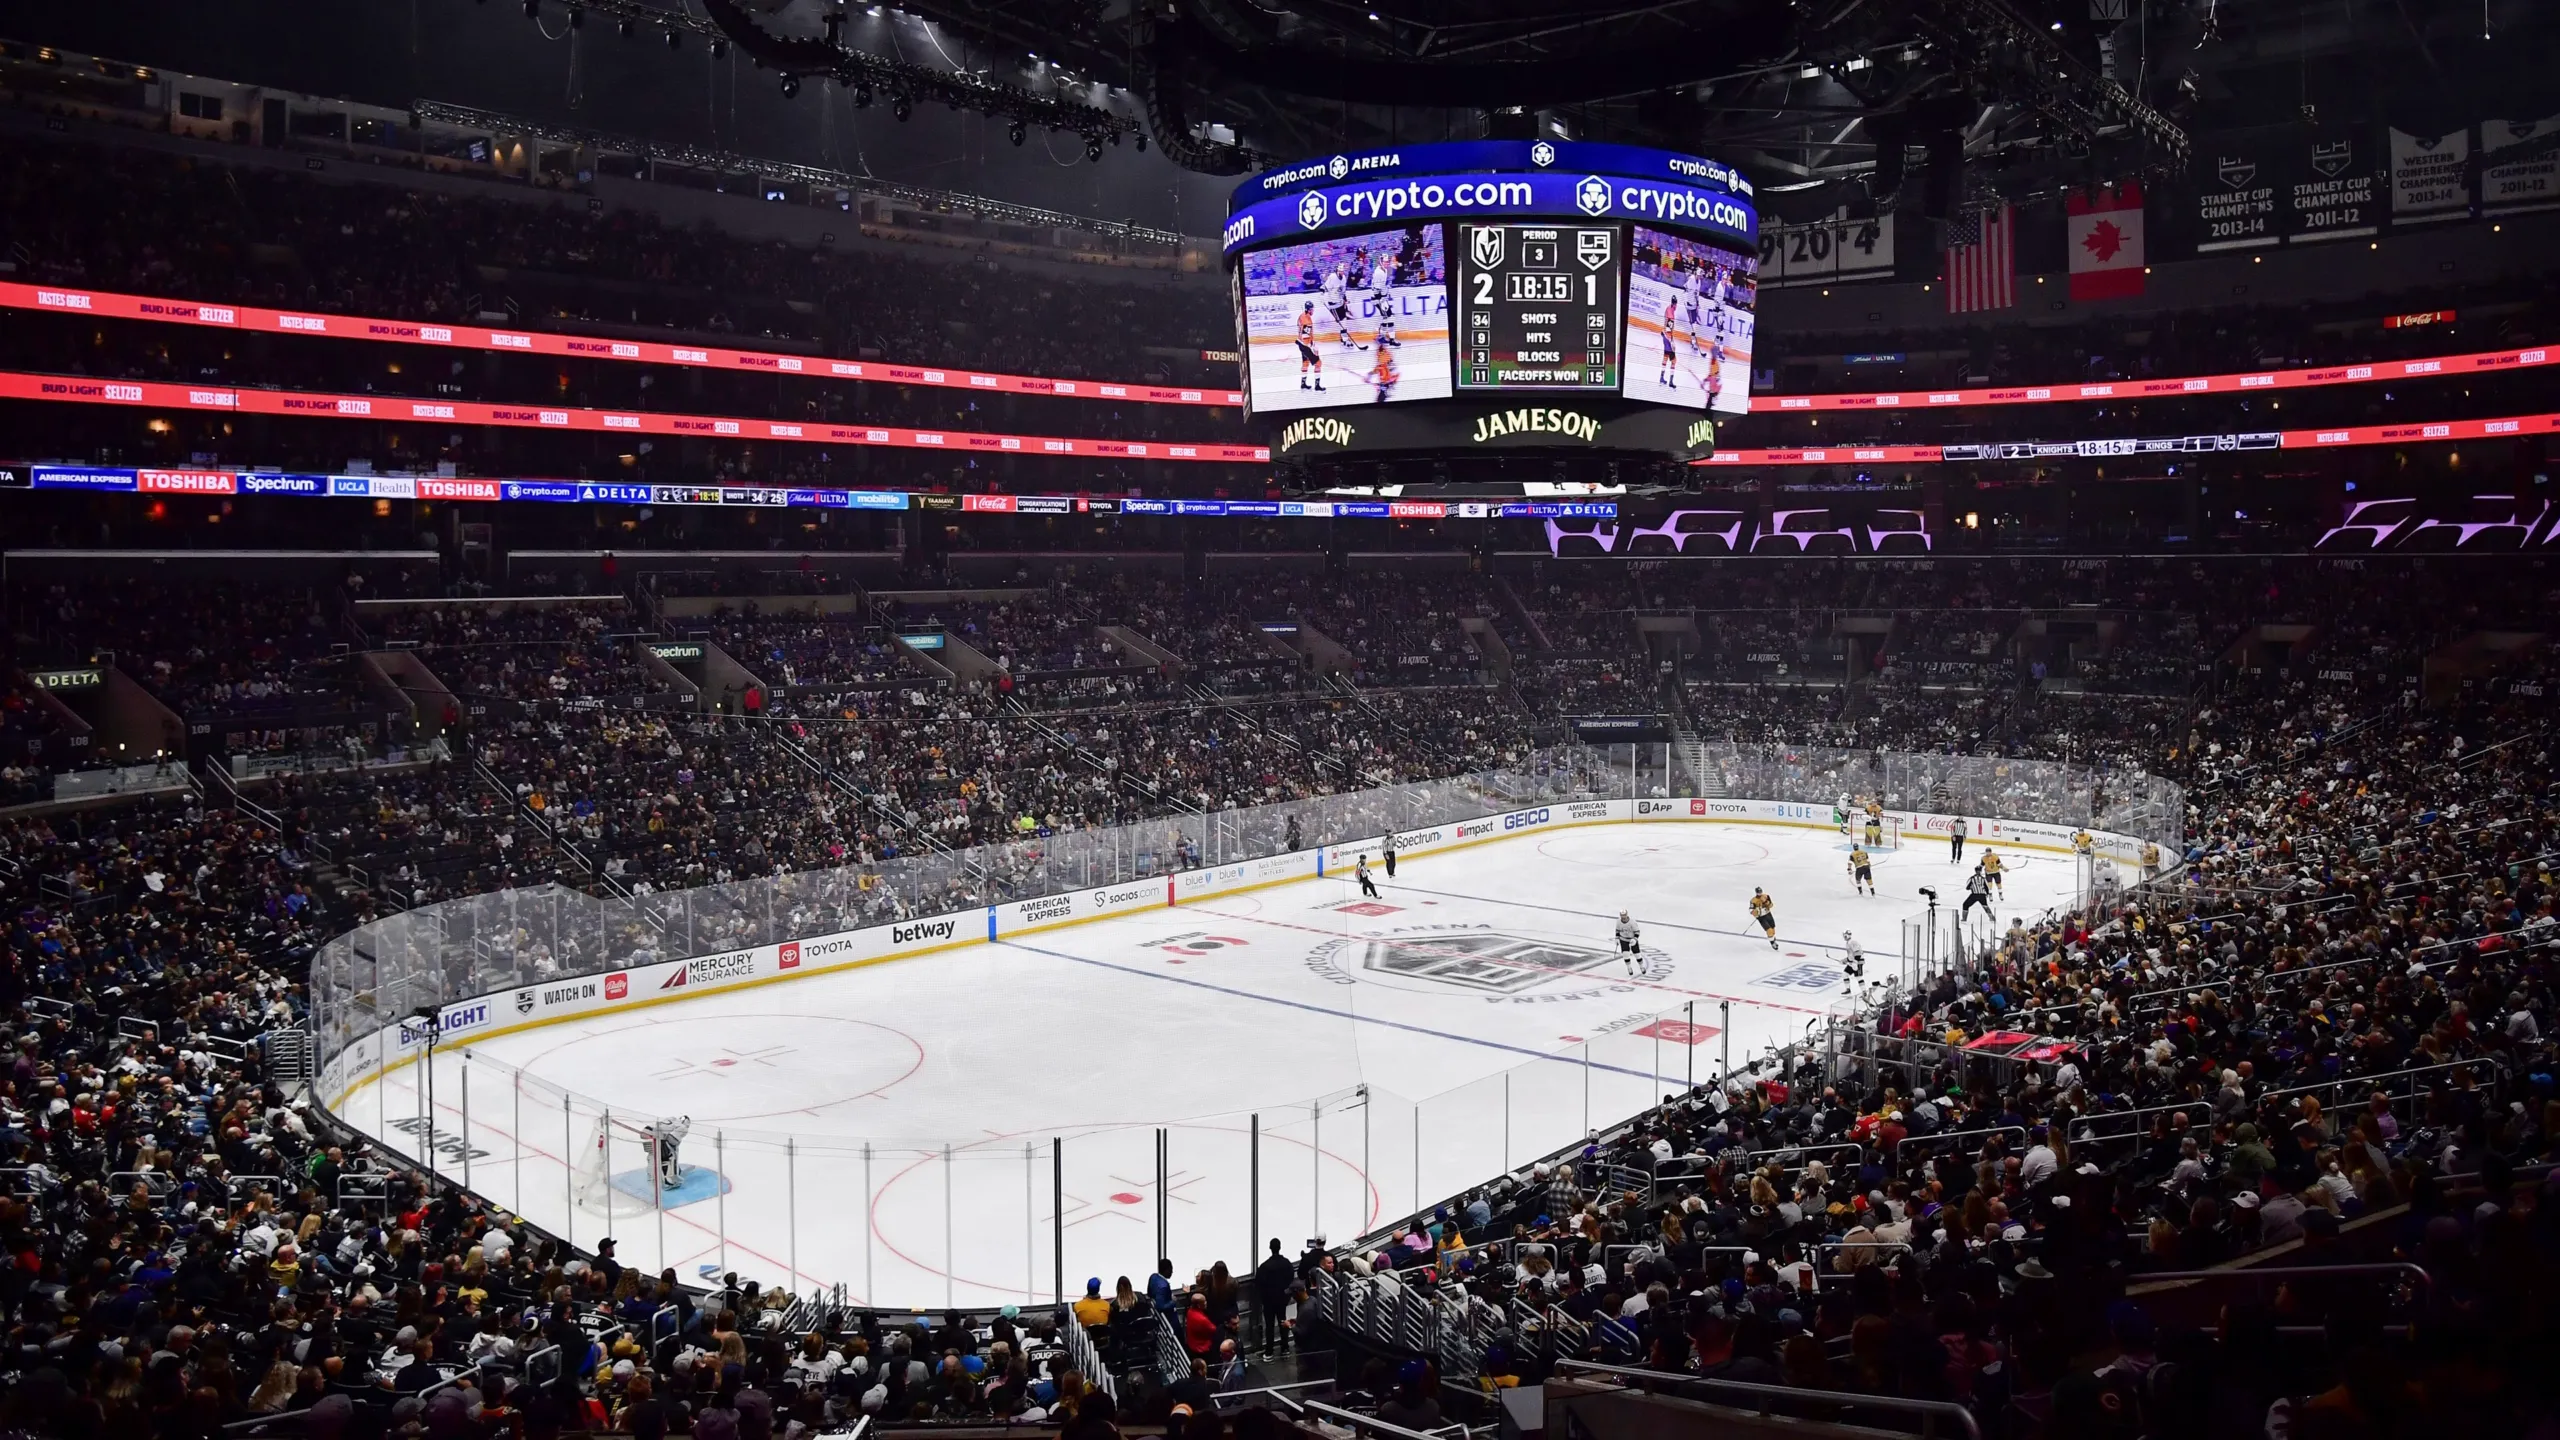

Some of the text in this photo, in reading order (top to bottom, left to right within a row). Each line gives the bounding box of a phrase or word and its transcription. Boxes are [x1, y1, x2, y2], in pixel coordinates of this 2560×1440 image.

[2403, 153, 2455, 166] WESTERN
[1263, 154, 1400, 189] crypto.com ARENA
[1669, 158, 1727, 183] crypto.com
[2294, 177, 2371, 196] STANLEY CUP
[2500, 179, 2546, 195] 2011-12
[1335, 180, 1532, 218] crypto.com
[2201, 188, 2273, 205] STANLEY CUP
[2294, 190, 2372, 210] CHAMPIONS
[2408, 189, 2453, 205] 2013-14
[1622, 184, 1747, 232] crypto.com
[2305, 209, 2360, 228] 2011-12
[1522, 230, 1557, 240] PERIOD
[2211, 219, 2265, 237] 2013-14
[1790, 230, 1830, 263] 20
[1854, 224, 1875, 255] 4
[1535, 248, 1543, 261] 3
[1473, 274, 1494, 305] 2
[1511, 276, 1567, 298] 18:15
[1585, 274, 1597, 305] 1
[38, 291, 65, 305] TASTES
[140, 304, 234, 323] BUD LIGHT SELTZER
[1473, 313, 1604, 328] 34 SHOTS 25
[369, 325, 389, 334] BUD
[391, 327, 419, 337] LIGHT
[1477, 331, 1600, 346] 9 HITS 9
[1477, 351, 1602, 365] 3 BLOCKS 11
[2497, 356, 2520, 364] LIGHT
[2520, 351, 2546, 364] SELTZER
[2325, 371, 2347, 379] LIGHT
[2347, 368, 2372, 379] SELTZER
[2405, 363, 2423, 373] TASTES
[1474, 369, 1603, 383] 11 FACEOFFS WON 15
[42, 383, 142, 401] BUD LIGHT SELTZER
[2027, 389, 2051, 400] SELTZER
[1473, 409, 1599, 443] JAMESON
[2400, 429, 2422, 437] LIGHT
[2423, 425, 2449, 437] SELTZER
[1281, 417, 1352, 453] JAMESON
[2010, 446, 2073, 457] 2 KNIGHTS
[2080, 441, 2121, 455] 18:15
[2146, 439, 2200, 450] KINGS 1
[39, 473, 132, 484] AMERICAN EXPRESS
[144, 474, 230, 490] TOSHIBA
[246, 476, 314, 491] Spectrum
[338, 482, 411, 494] UCLA Health
[421, 482, 496, 497] TOSHIBA
[522, 486, 570, 497] crypto.com
[599, 487, 647, 499] DELTA
[662, 491, 669, 500] 2
[682, 491, 688, 501] 1
[699, 490, 719, 501] 18:15
[726, 492, 781, 503] SHOTS 34 25
[820, 493, 847, 503] ULTRA
[857, 494, 900, 505] mobilitie
[1089, 502, 1112, 510] TOYOTA
[1126, 501, 1163, 512] Spectrum
[1186, 504, 1220, 513] crypto.com
[1285, 504, 1330, 515] UCLA Health
[1349, 506, 1384, 515] crypto.com
[1392, 505, 1443, 515] TOSHIBA
[1533, 506, 1557, 514] ULTRA
[1575, 506, 1614, 514] DELTA
[2077, 559, 2108, 569] KINGS
[1408, 655, 1430, 665] KINGS
[1756, 654, 1780, 662] KINGS
[49, 673, 100, 686] DELTA
[2318, 670, 2354, 681] LA KINGS
[2521, 685, 2543, 697] KINGS
[680, 695, 694, 703] 110
[470, 706, 486, 715] 110
[191, 725, 211, 735] 109
[70, 736, 88, 747] 108
[1568, 802, 1606, 812] AMERICAN
[1572, 809, 1607, 819] EXPRESS
[1710, 804, 1747, 813] TOYOTA
[1778, 805, 1812, 819] BLUE
[1504, 808, 1549, 830] GEICO
[1464, 820, 1494, 838] impact
[2003, 826, 2020, 834] Order
[2021, 827, 2038, 836] ahead
[2057, 832, 2068, 840] app
[1397, 831, 1440, 849] Spectrum
[1340, 849, 1351, 857] Order
[1352, 847, 1364, 855] ahead
[1185, 875, 1203, 886] blue
[1220, 868, 1236, 879] blue
[1020, 896, 1070, 913] AMERICAN
[1027, 906, 1071, 922] EXPRESS
[892, 920, 955, 944] betway
[805, 940, 853, 958] TOYOTA
[690, 952, 754, 972] MERCURY
[1304, 938, 1358, 985] crypto.com
[690, 964, 754, 984] INSURANCE
[1762, 964, 1831, 987] LIGHT
[1797, 970, 1843, 988] BUD
[545, 984, 596, 1005] WATCH ON
[1591, 1011, 1653, 1032] TOYOTA
[580, 1316, 601, 1326] QUICK
